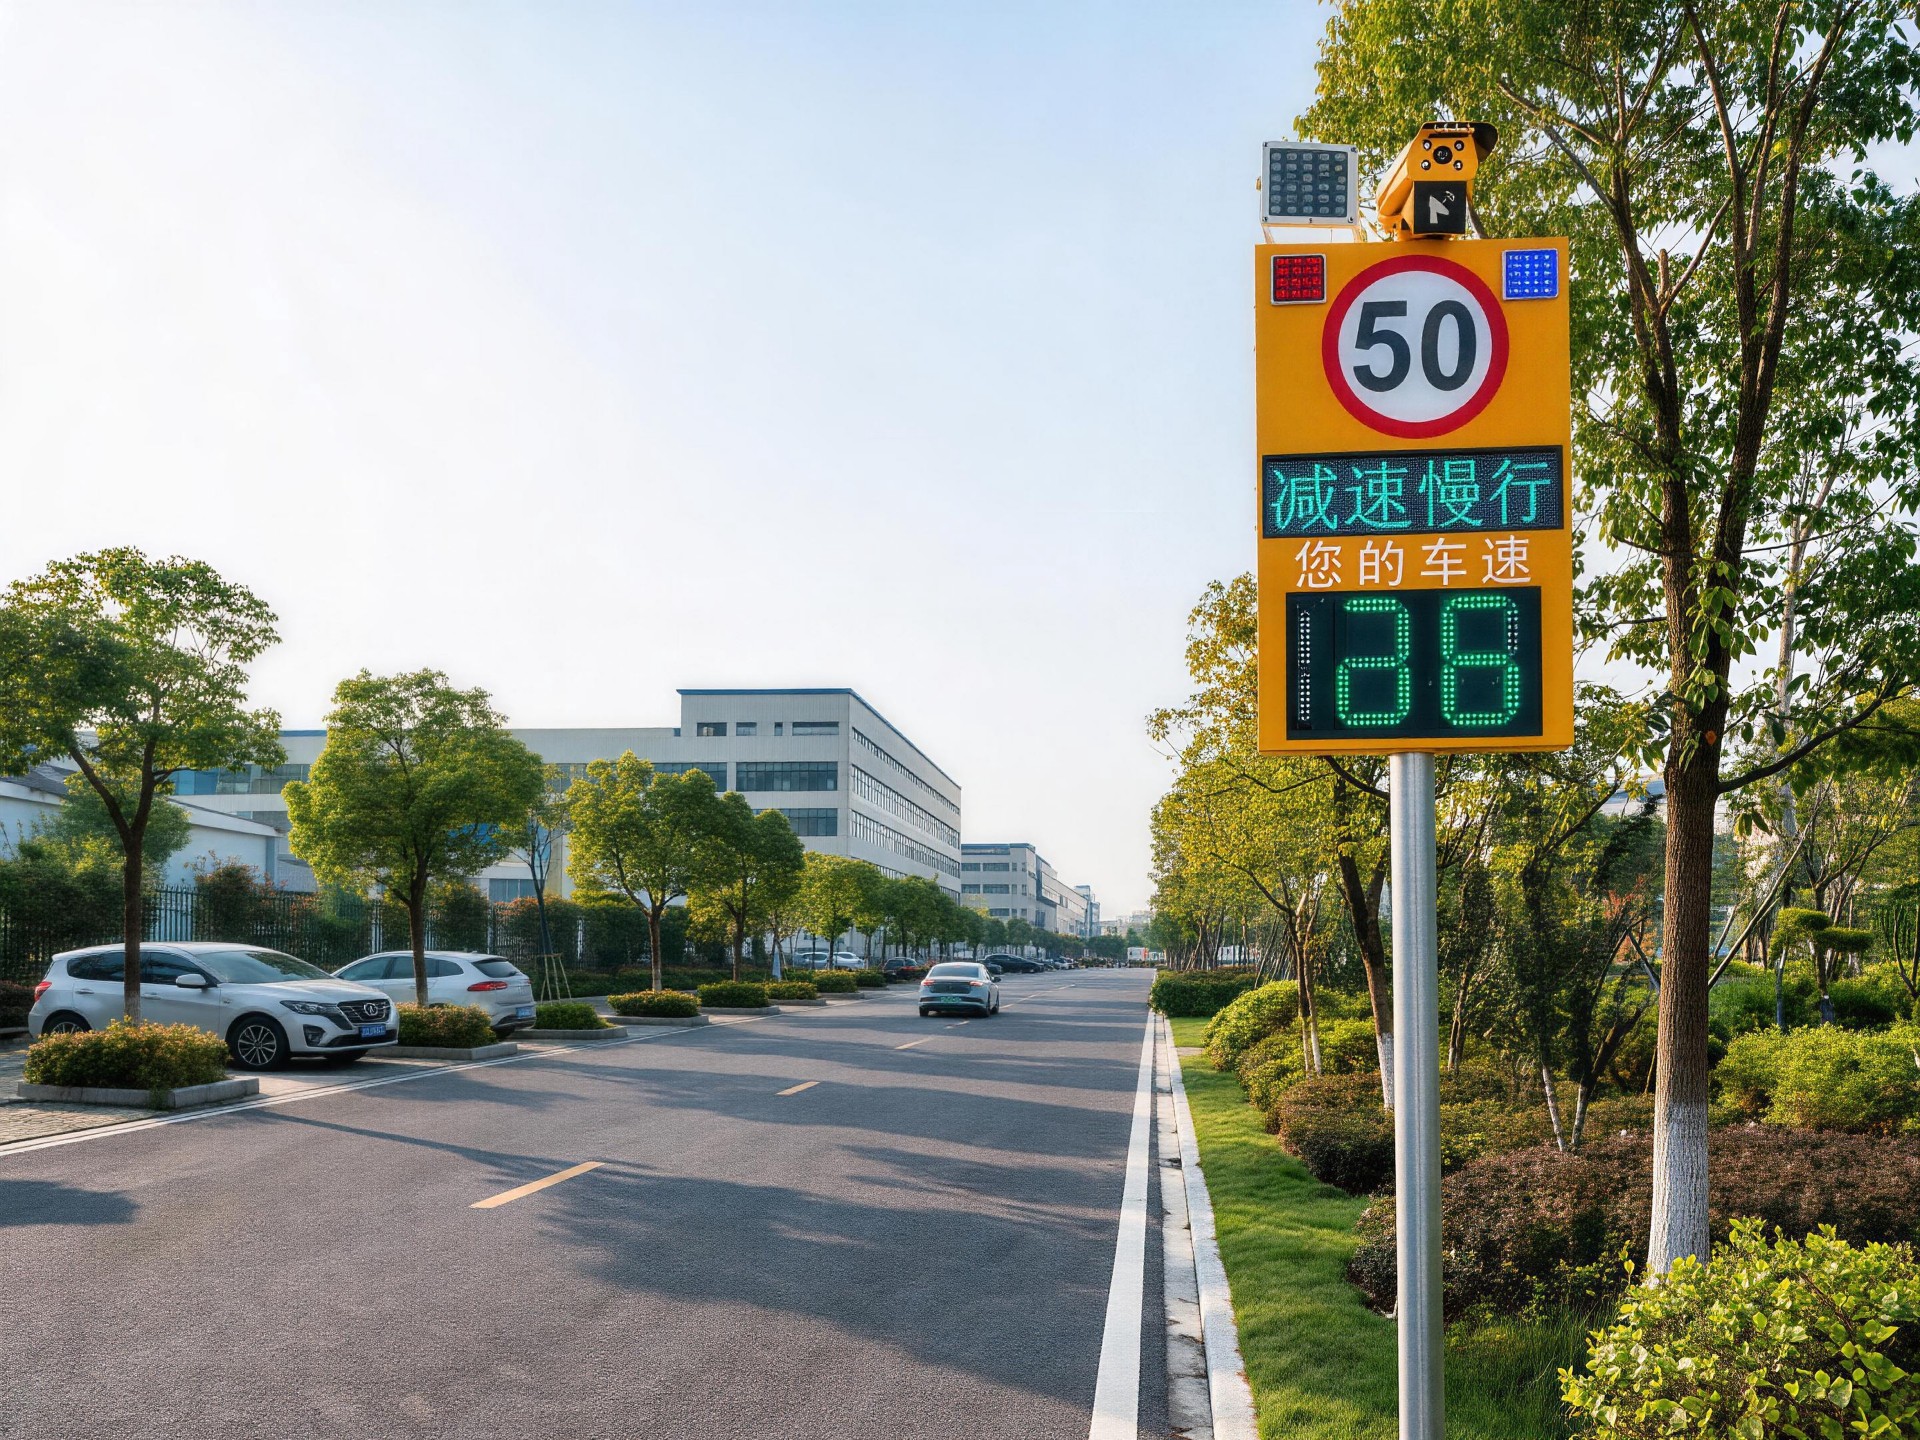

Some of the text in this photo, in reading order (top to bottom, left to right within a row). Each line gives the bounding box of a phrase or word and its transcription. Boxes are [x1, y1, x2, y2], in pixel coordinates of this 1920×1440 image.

[1353, 299, 1477, 393] 50
[1270, 459, 1551, 531] 减速慢行
[1294, 534, 1531, 588] 您的车速
